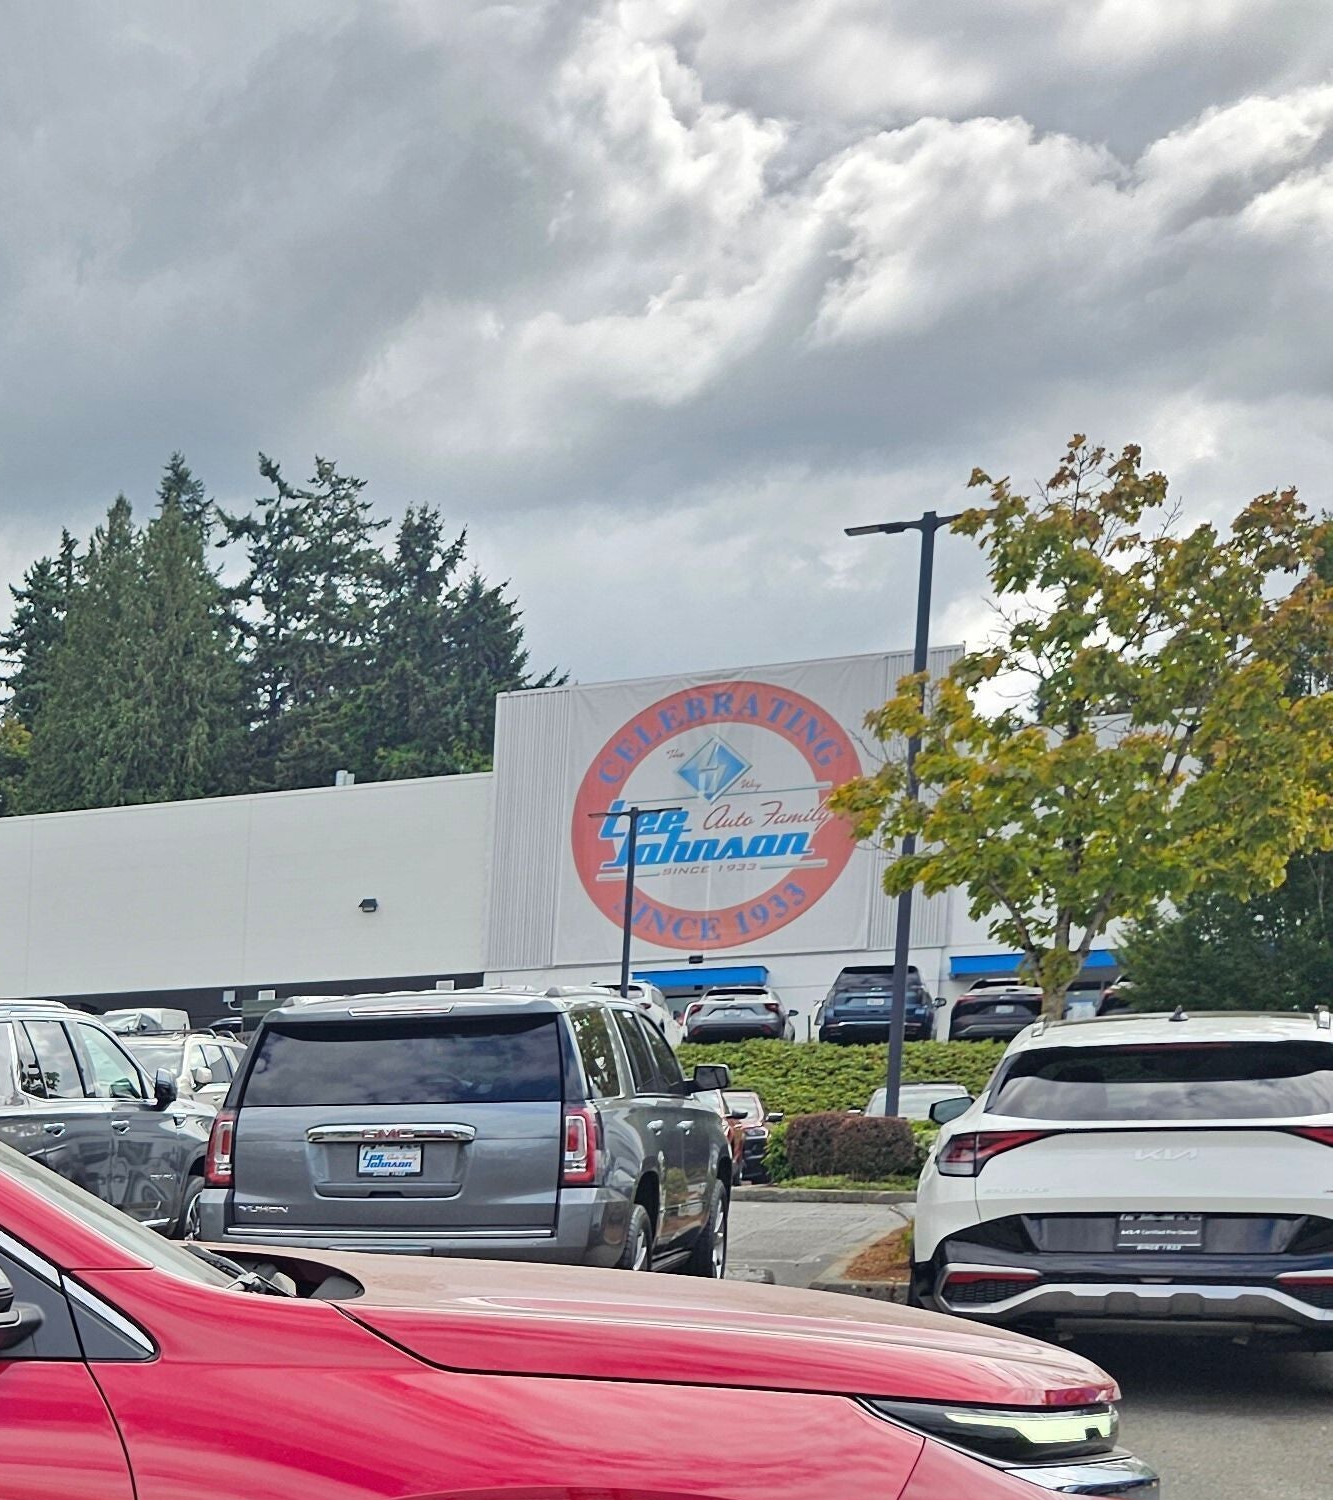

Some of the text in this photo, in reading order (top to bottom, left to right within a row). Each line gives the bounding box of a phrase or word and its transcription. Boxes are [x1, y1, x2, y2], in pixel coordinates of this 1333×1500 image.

[598, 692, 844, 785] CELEBRATING
[599, 800, 833, 839] Lee Auto Family
[602, 826, 813, 868] Johnson
[662, 862, 758, 876] SINCE 1933
[735, 881, 807, 935] 1933
[361, 1127, 415, 1139] GMC
[1134, 1146, 1198, 1161] KIA
